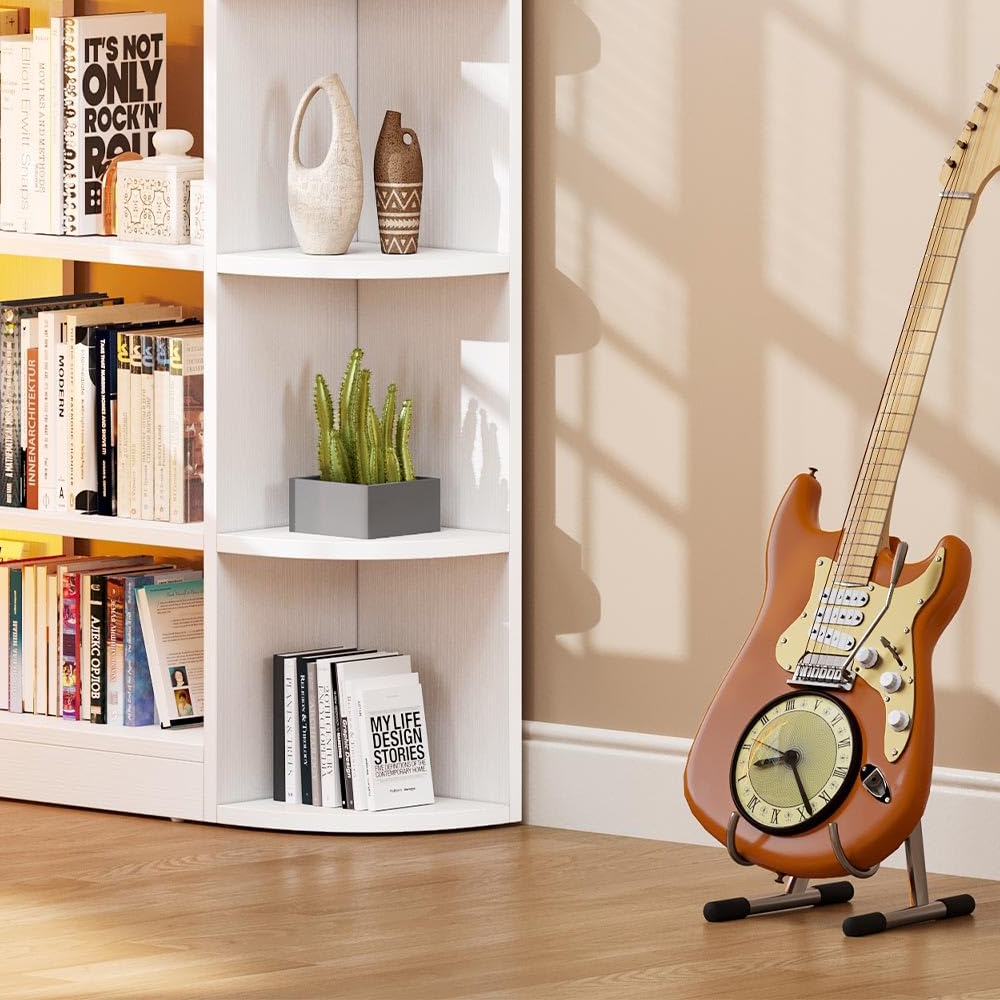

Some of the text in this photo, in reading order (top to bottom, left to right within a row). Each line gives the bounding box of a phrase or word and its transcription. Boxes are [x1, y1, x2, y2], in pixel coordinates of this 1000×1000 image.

[84, 33, 164, 63] IT'S NOT
[21, 47, 32, 91] Elliott
[82, 59, 163, 106] ONLY
[21, 99, 32, 146] Erwitt
[84, 102, 162, 133] ROCK'N'
[28, 359, 36, 486] INNENARCHITEKTUR
[91, 616, 101, 699] АЛЕКС ОРЛОВ
[301, 713, 307, 722] &
[814, 699, 822, 711] V
[286, 724, 293, 734] &
[318, 685, 327, 778] ENCYCLOPEDIA
[370, 711, 422, 733] MY LIFE
[325, 722, 333, 776] CENTURY
[372, 727, 423, 749] DESIGN
[374, 745, 425, 765] STORIES
[384, 762, 411, 770] DEFINITIONS
[375, 768, 412, 778] CONTEMPORARY
